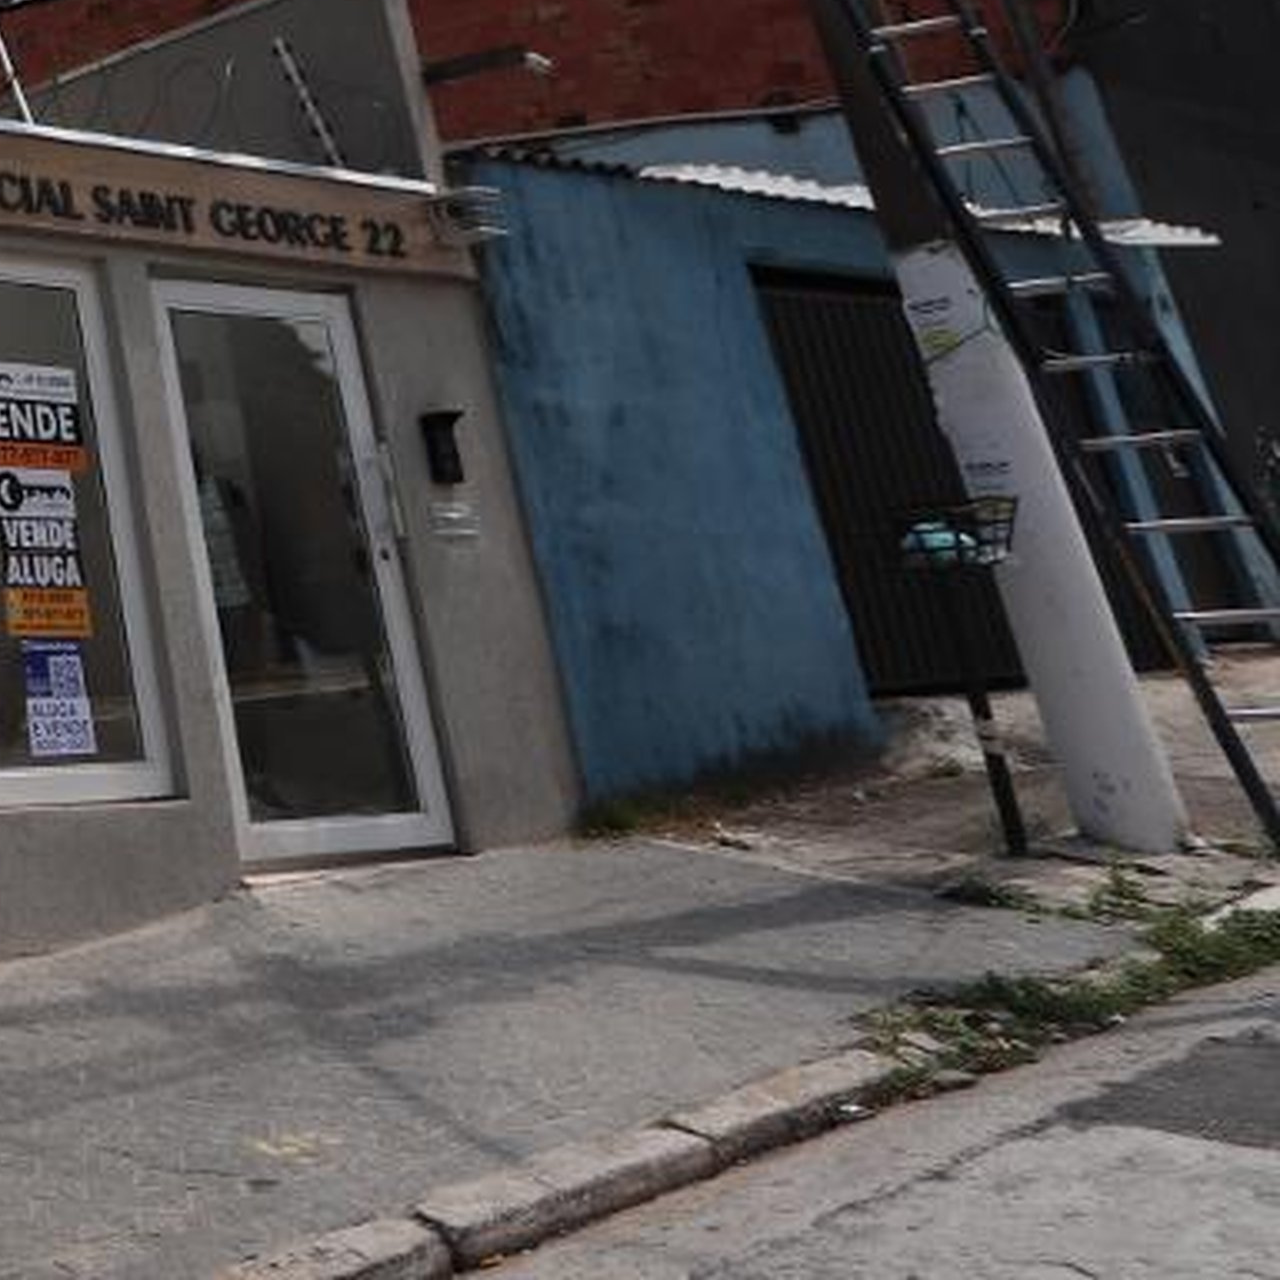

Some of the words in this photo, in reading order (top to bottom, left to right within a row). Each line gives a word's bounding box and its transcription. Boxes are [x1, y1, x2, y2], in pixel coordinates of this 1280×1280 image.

[92, 185, 197, 234] SAINT
[210, 199, 352, 252] GEORGE
[361, 218, 407, 258] 22
[2, 519, 76, 549] VENDE
[7, 555, 83, 587] ALUGA
